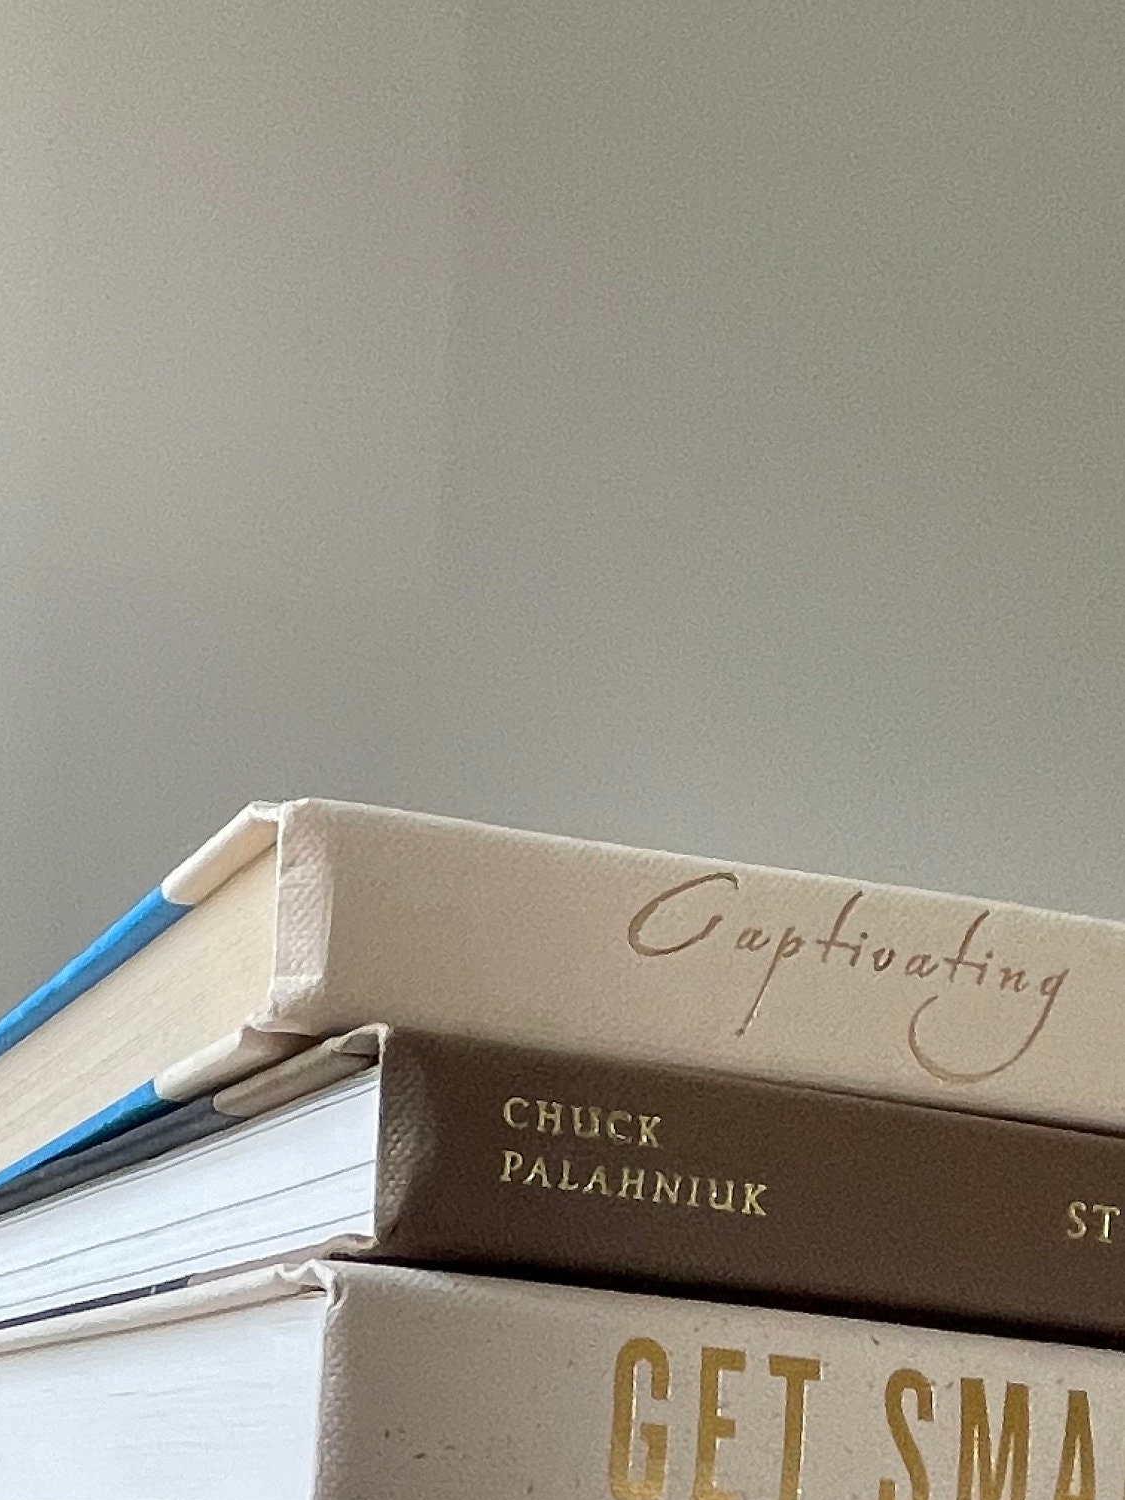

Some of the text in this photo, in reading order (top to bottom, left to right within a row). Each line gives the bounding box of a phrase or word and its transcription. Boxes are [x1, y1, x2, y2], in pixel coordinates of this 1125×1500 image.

[627, 871, 1071, 1085] Captivating
[502, 1096, 664, 1149] CHUCK
[498, 1149, 768, 1218] PALAHNIUK
